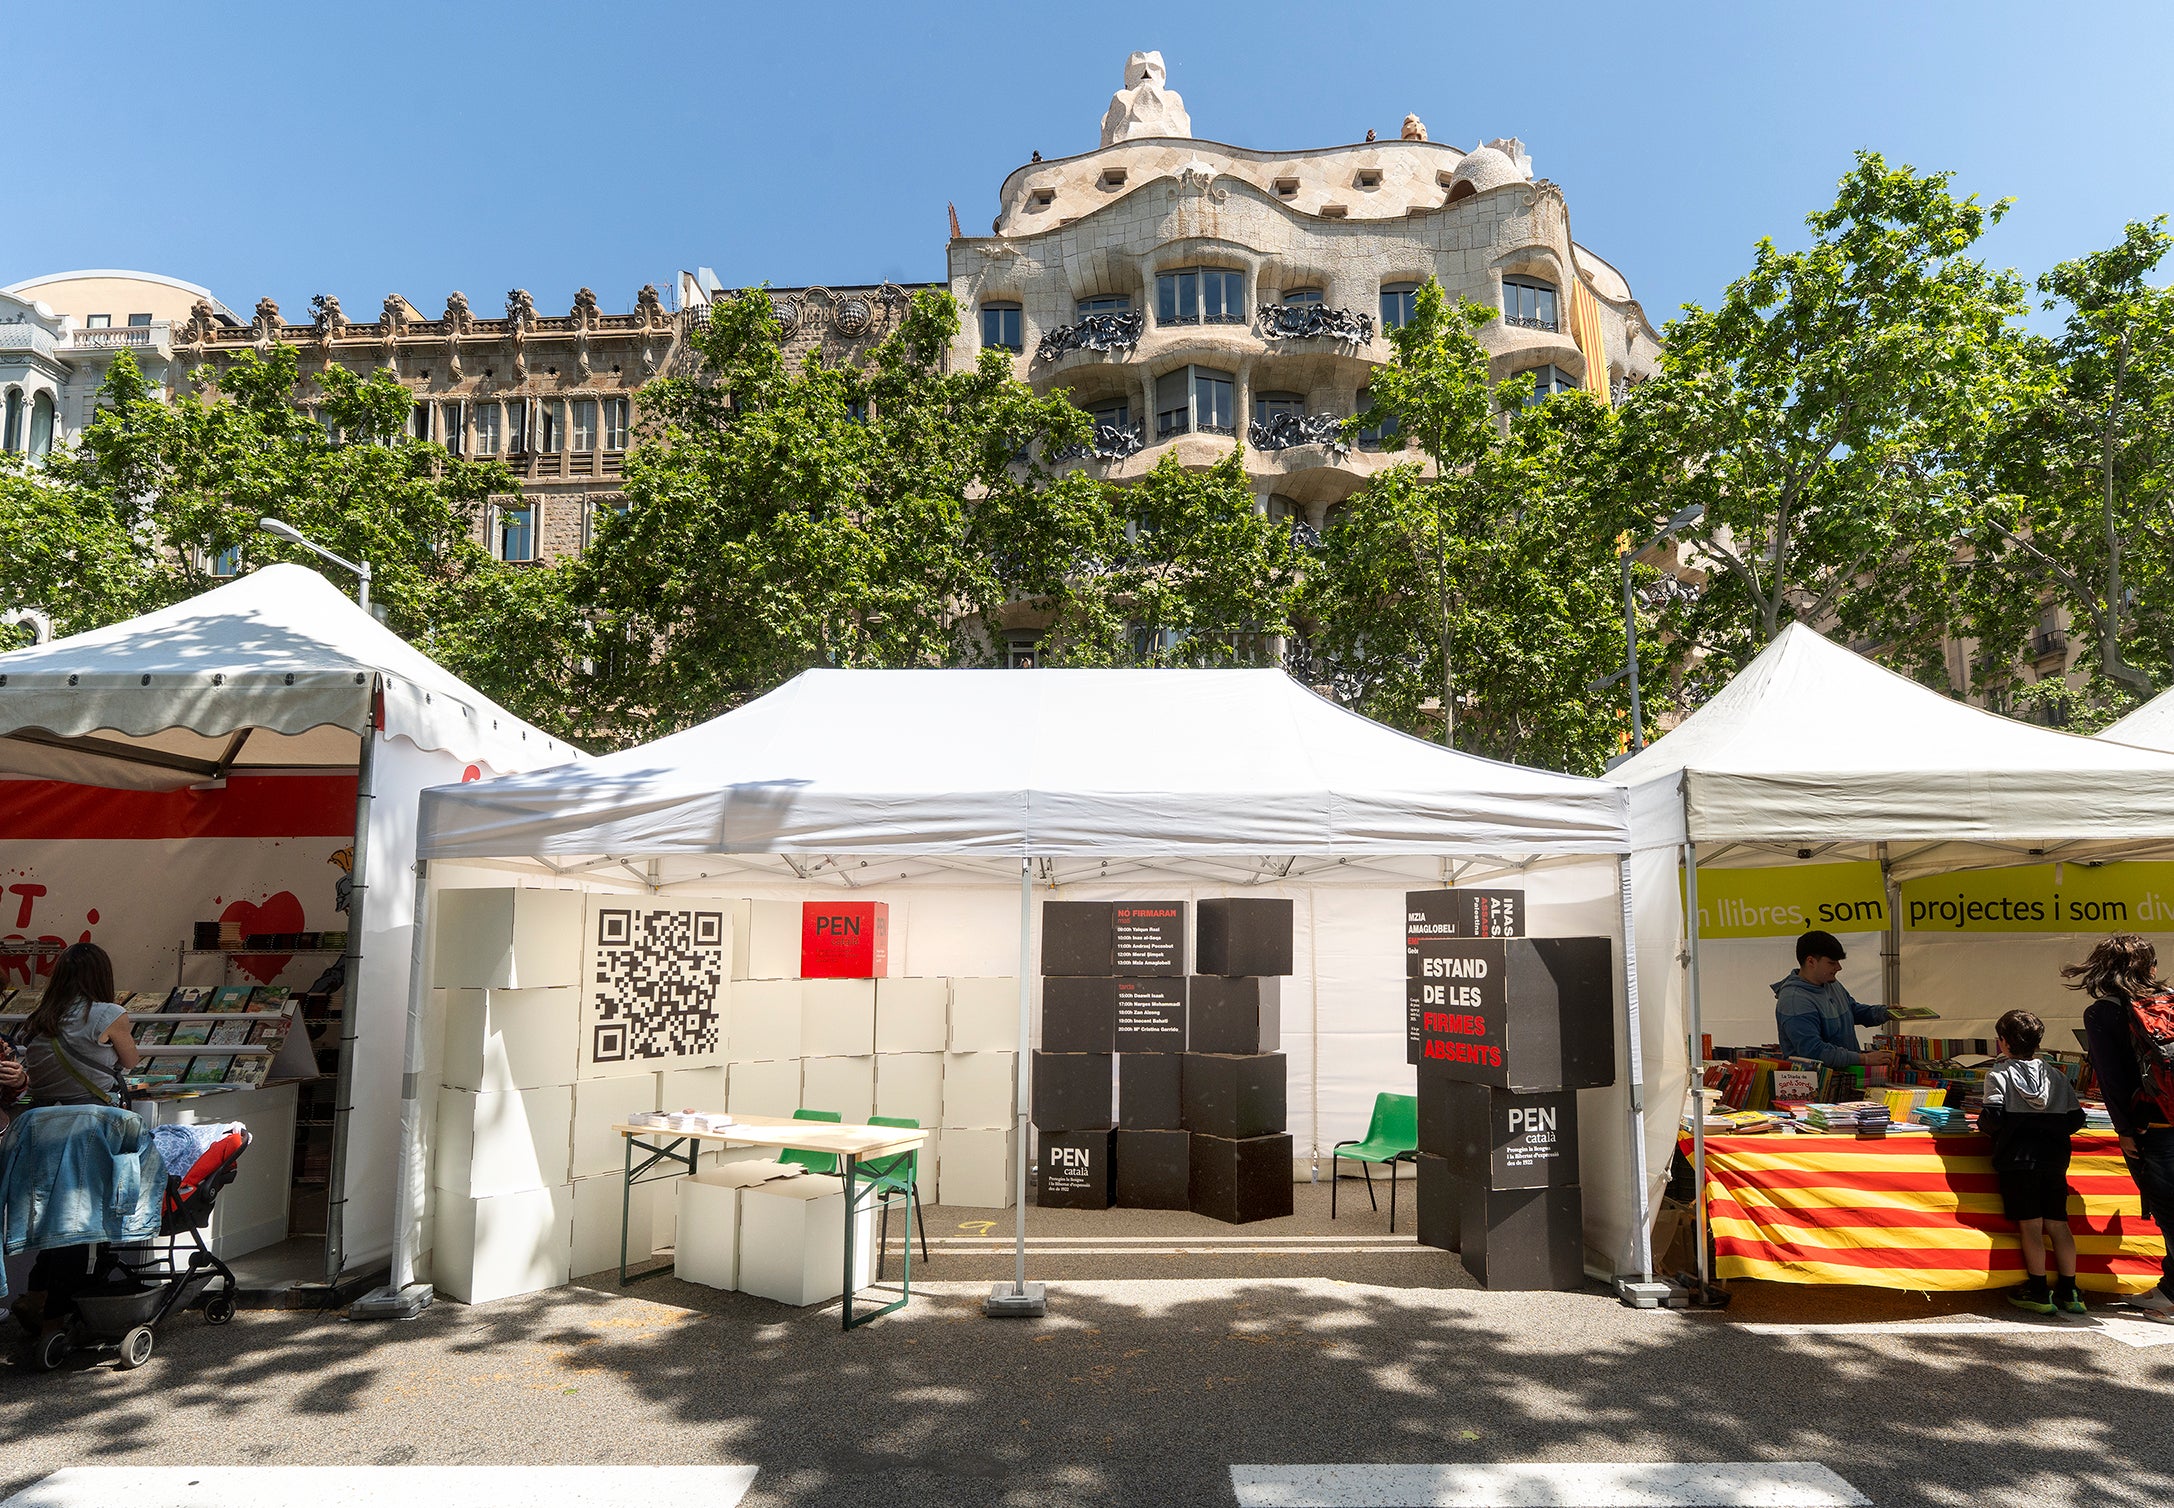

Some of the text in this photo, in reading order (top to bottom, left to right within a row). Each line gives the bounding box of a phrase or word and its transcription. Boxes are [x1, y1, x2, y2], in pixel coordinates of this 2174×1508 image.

[1117, 909, 1177, 917] NO FIRMARAN
[1408, 913, 1426, 922] MZIA
[1491, 897, 1501, 938] AL-S
[1504, 898, 1513, 937] INAS
[1717, 898, 1811, 928] llibres,
[1818, 900, 1882, 923] som
[1910, 893, 2044, 928] projectes
[2054, 894, 2060, 920] i
[2070, 901, 2127, 921] som
[816, 916, 860, 936] PEN
[1408, 924, 1455, 934] AMAGLOBELI
[1423, 958, 1487, 978] ESTAND
[1424, 985, 1481, 1007] DE LES
[1424, 1012, 1485, 1037] FIRMES
[1424, 1039, 1502, 1068] ABSENTS
[1508, 1107, 1556, 1133] PEN
[1525, 1132, 1556, 1143] català
[1051, 1147, 1089, 1167] PEN
[1064, 1167, 1089, 1176] català
